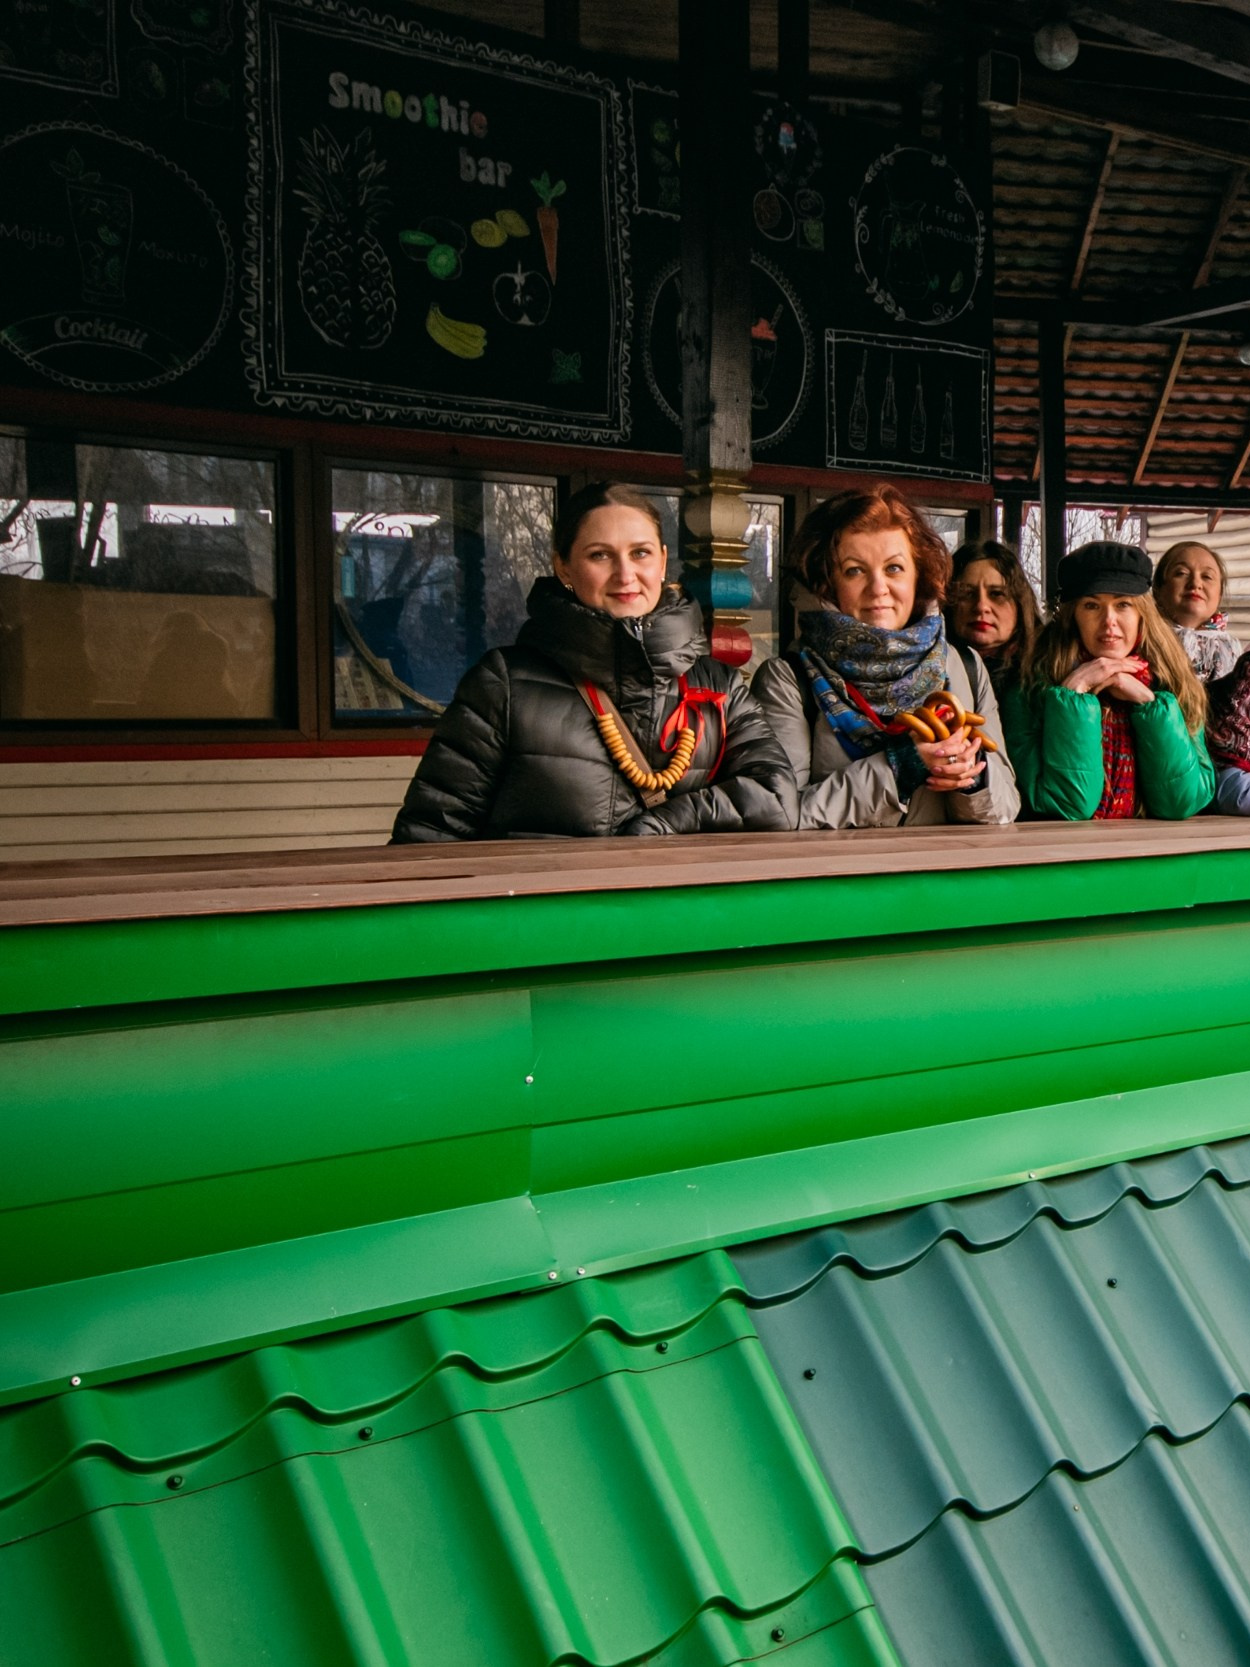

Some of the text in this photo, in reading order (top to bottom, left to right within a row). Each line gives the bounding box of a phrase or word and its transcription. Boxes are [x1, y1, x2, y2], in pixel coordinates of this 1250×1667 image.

[328, 71, 489, 139] Smoothie
[458, 147, 513, 188] bar
[0, 222, 65, 250] Mojito
[53, 315, 149, 350] Cocktail
